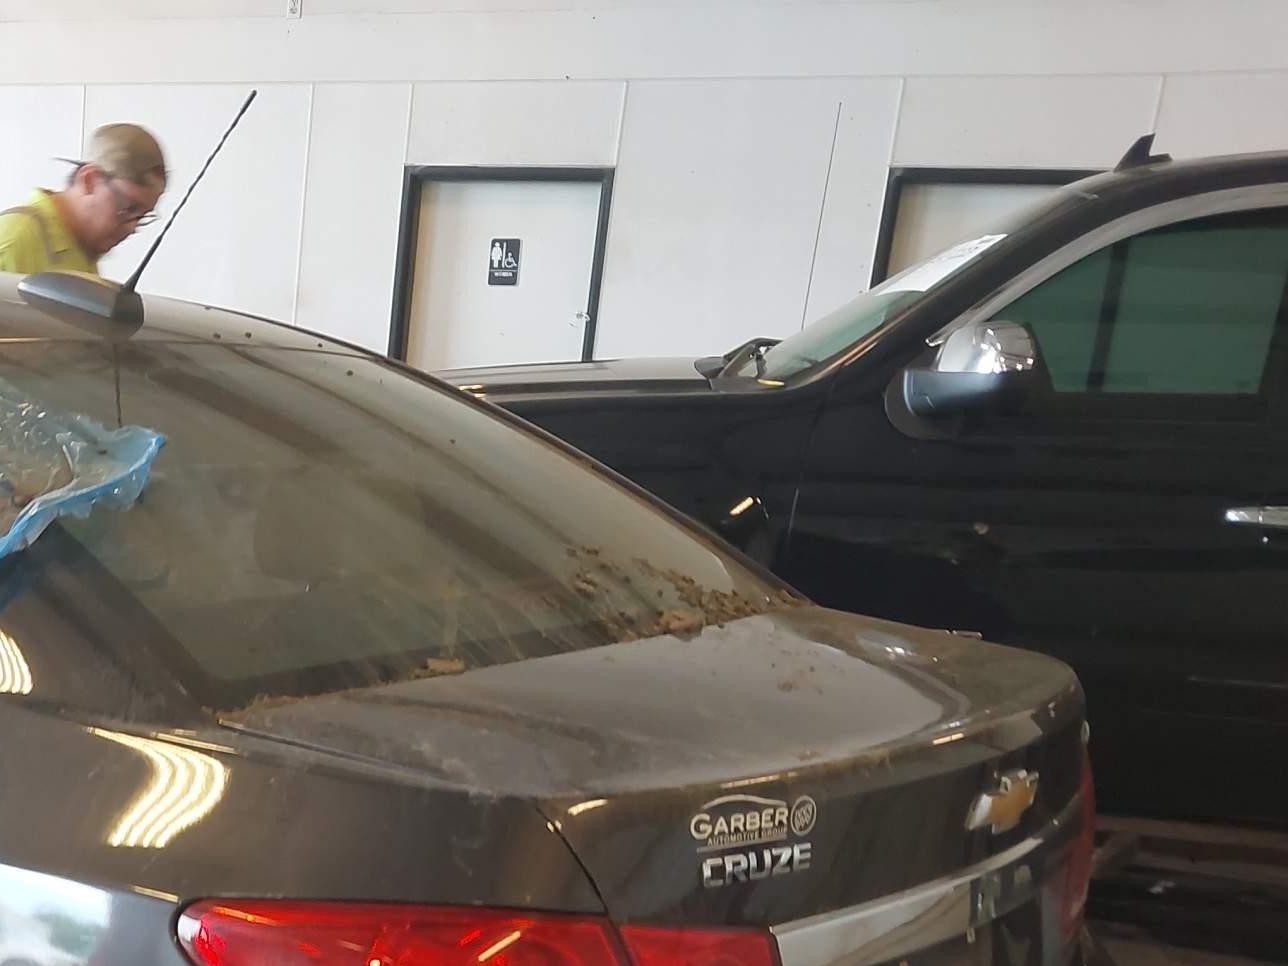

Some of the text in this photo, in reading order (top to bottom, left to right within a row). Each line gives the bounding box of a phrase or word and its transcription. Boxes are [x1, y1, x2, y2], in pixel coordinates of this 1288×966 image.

[690, 807, 789, 841] GARBER
[707, 830, 759, 847] AUTOMOTIVE
[702, 842, 812, 889] CRUZE
